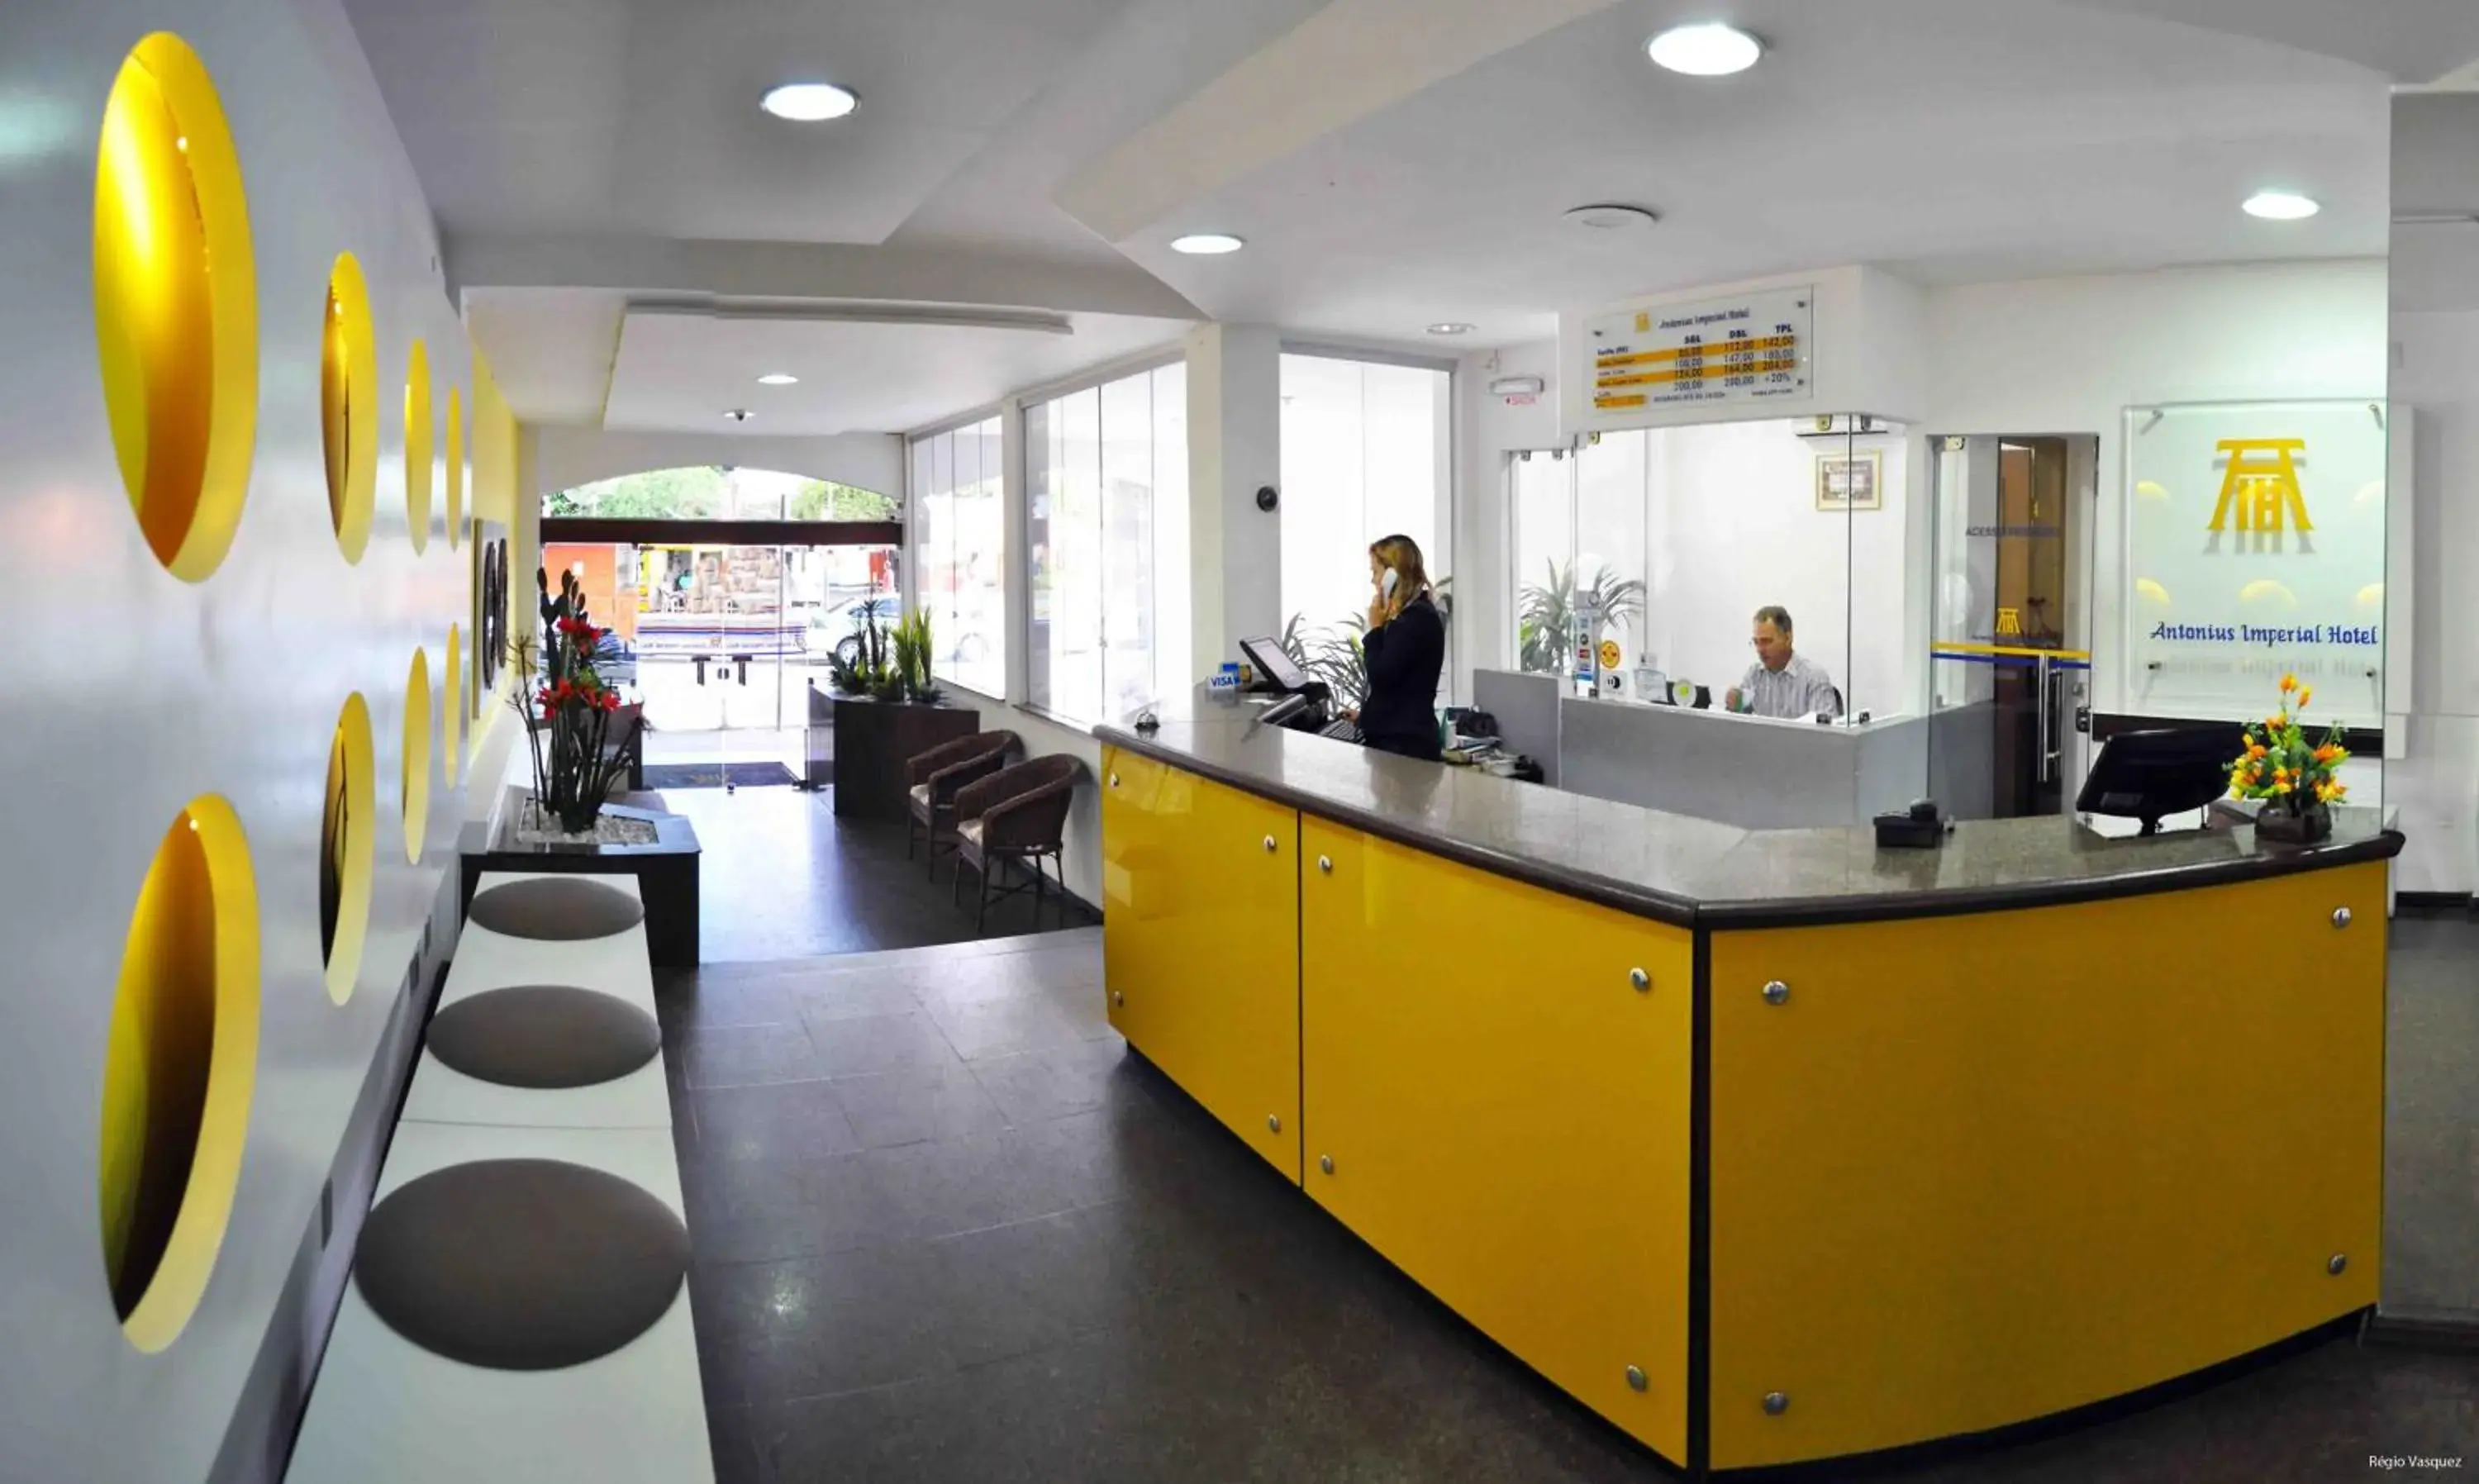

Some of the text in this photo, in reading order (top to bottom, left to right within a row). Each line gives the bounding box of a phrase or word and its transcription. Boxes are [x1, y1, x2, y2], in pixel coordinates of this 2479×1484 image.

[2149, 621, 2378, 648] Antonius Imperial Hotel
[1211, 676, 1234, 687] VISA
